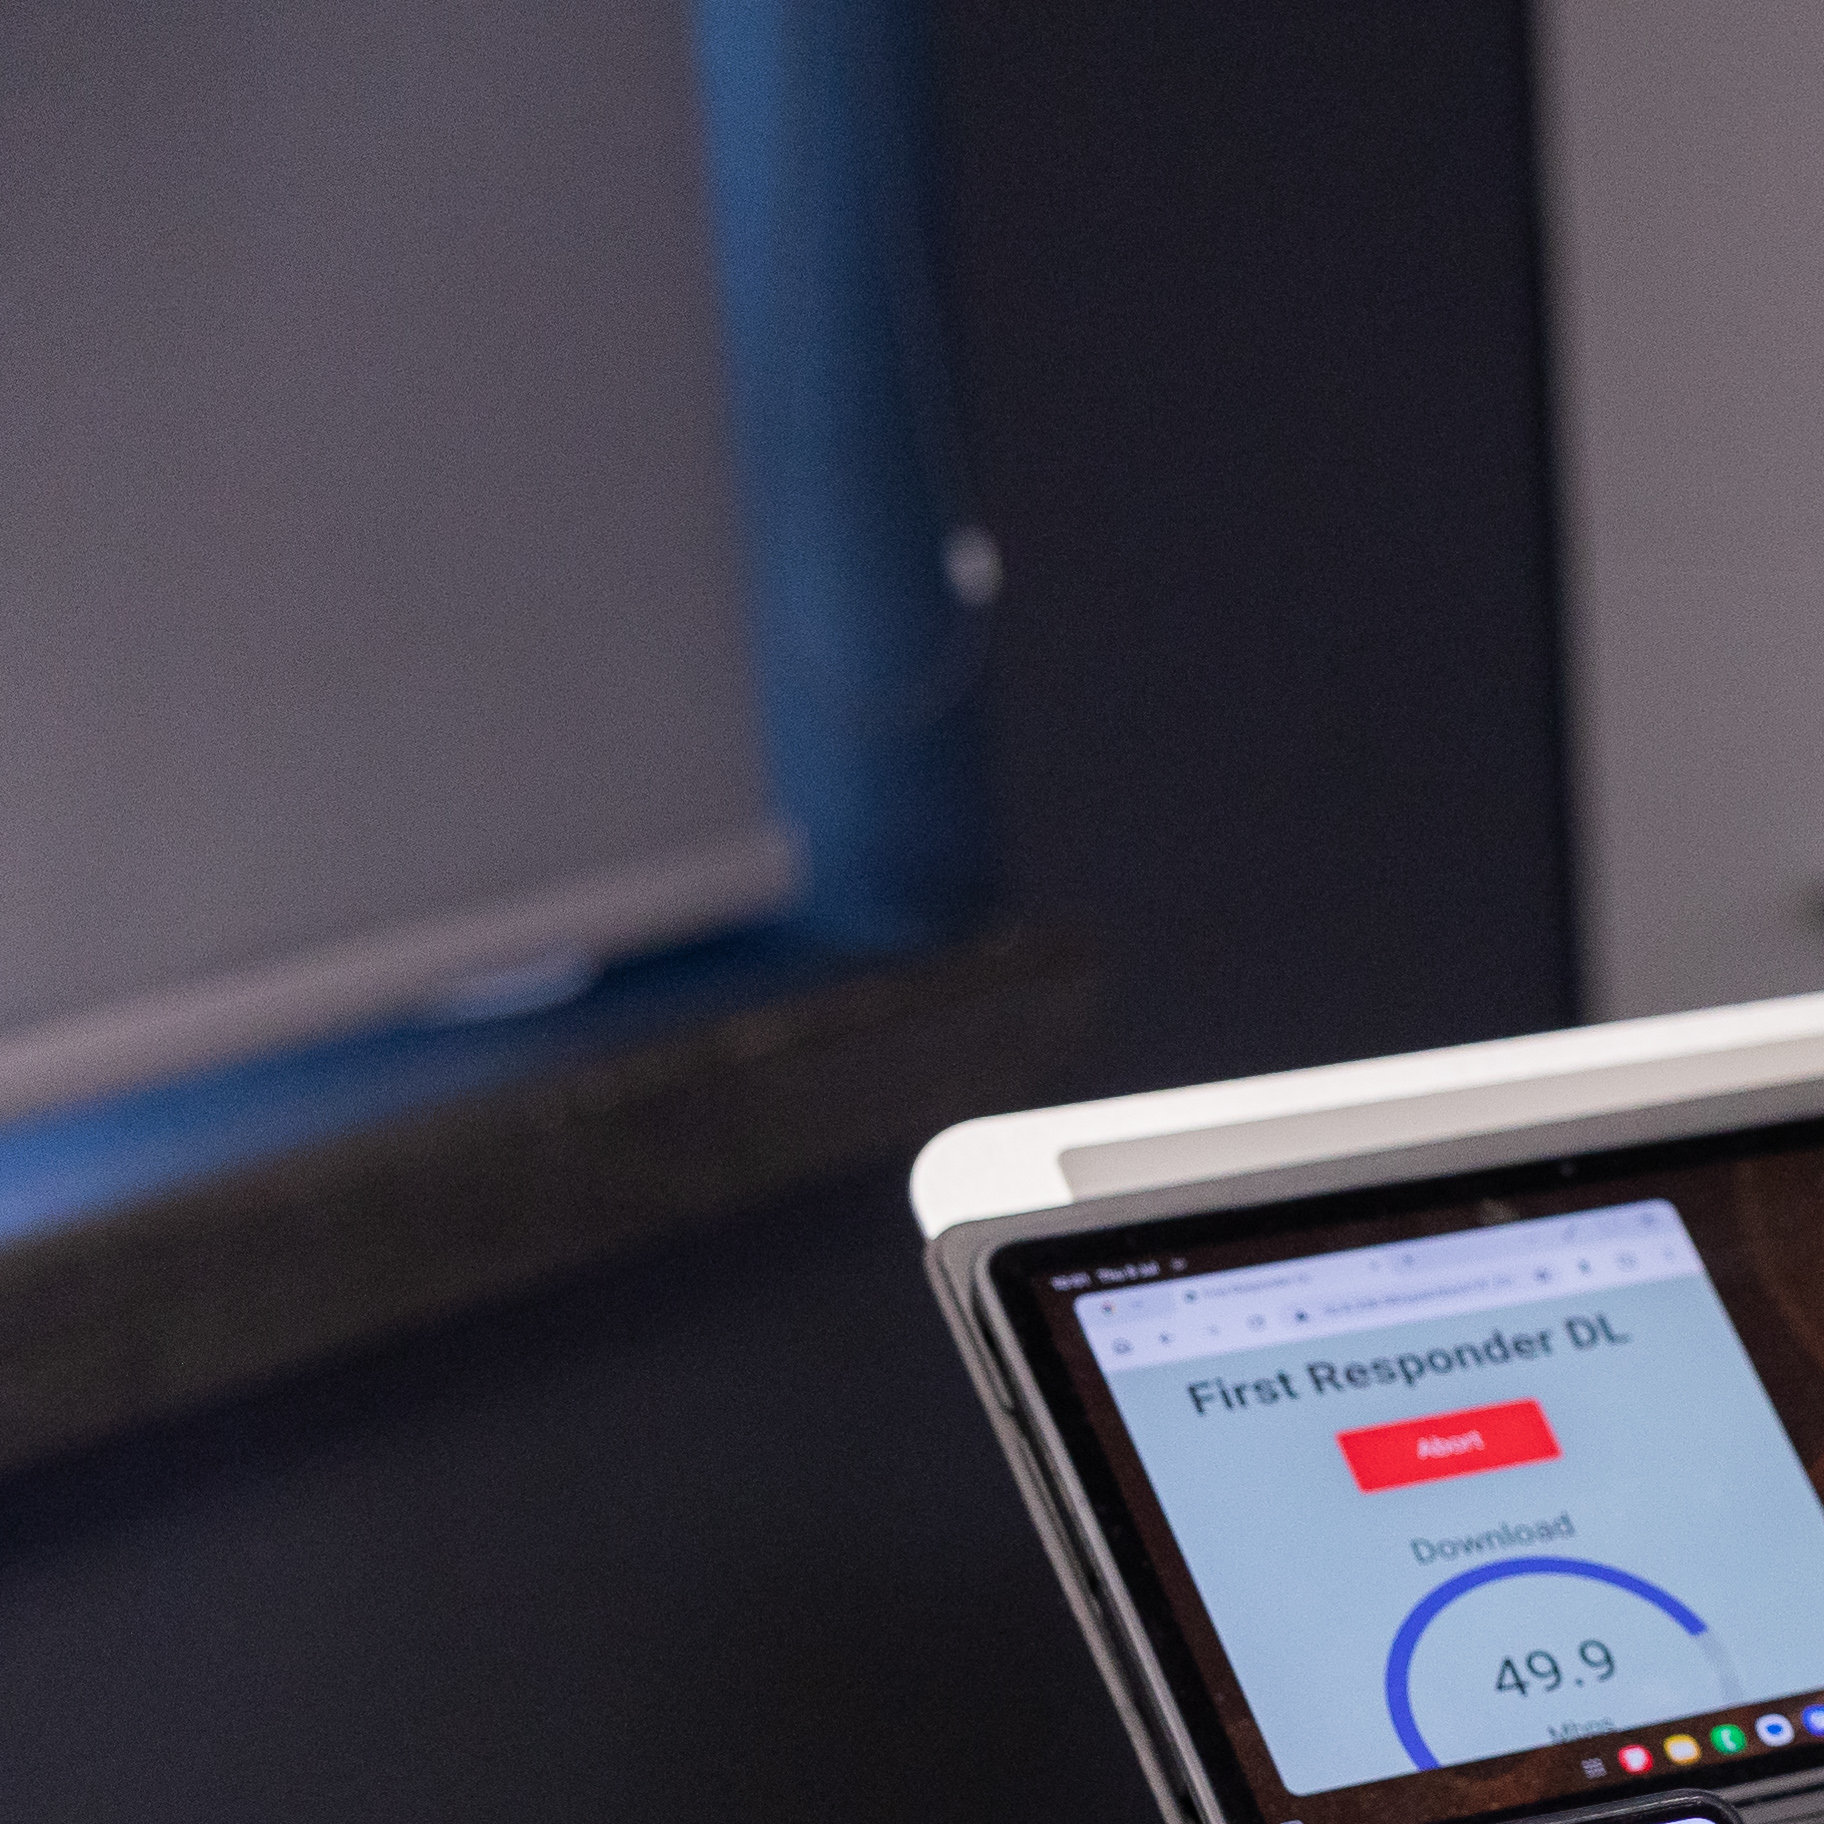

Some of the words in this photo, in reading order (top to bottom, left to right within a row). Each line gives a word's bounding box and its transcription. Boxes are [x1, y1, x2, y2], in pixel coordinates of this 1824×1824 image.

[1187, 1368, 1297, 1414] First
[1305, 1326, 1552, 1395] Responder
[1563, 1310, 1628, 1350] DL
[1416, 1428, 1484, 1459] Abort
[1409, 1511, 1575, 1565] Download
[1493, 1637, 1615, 1697] 49.9
